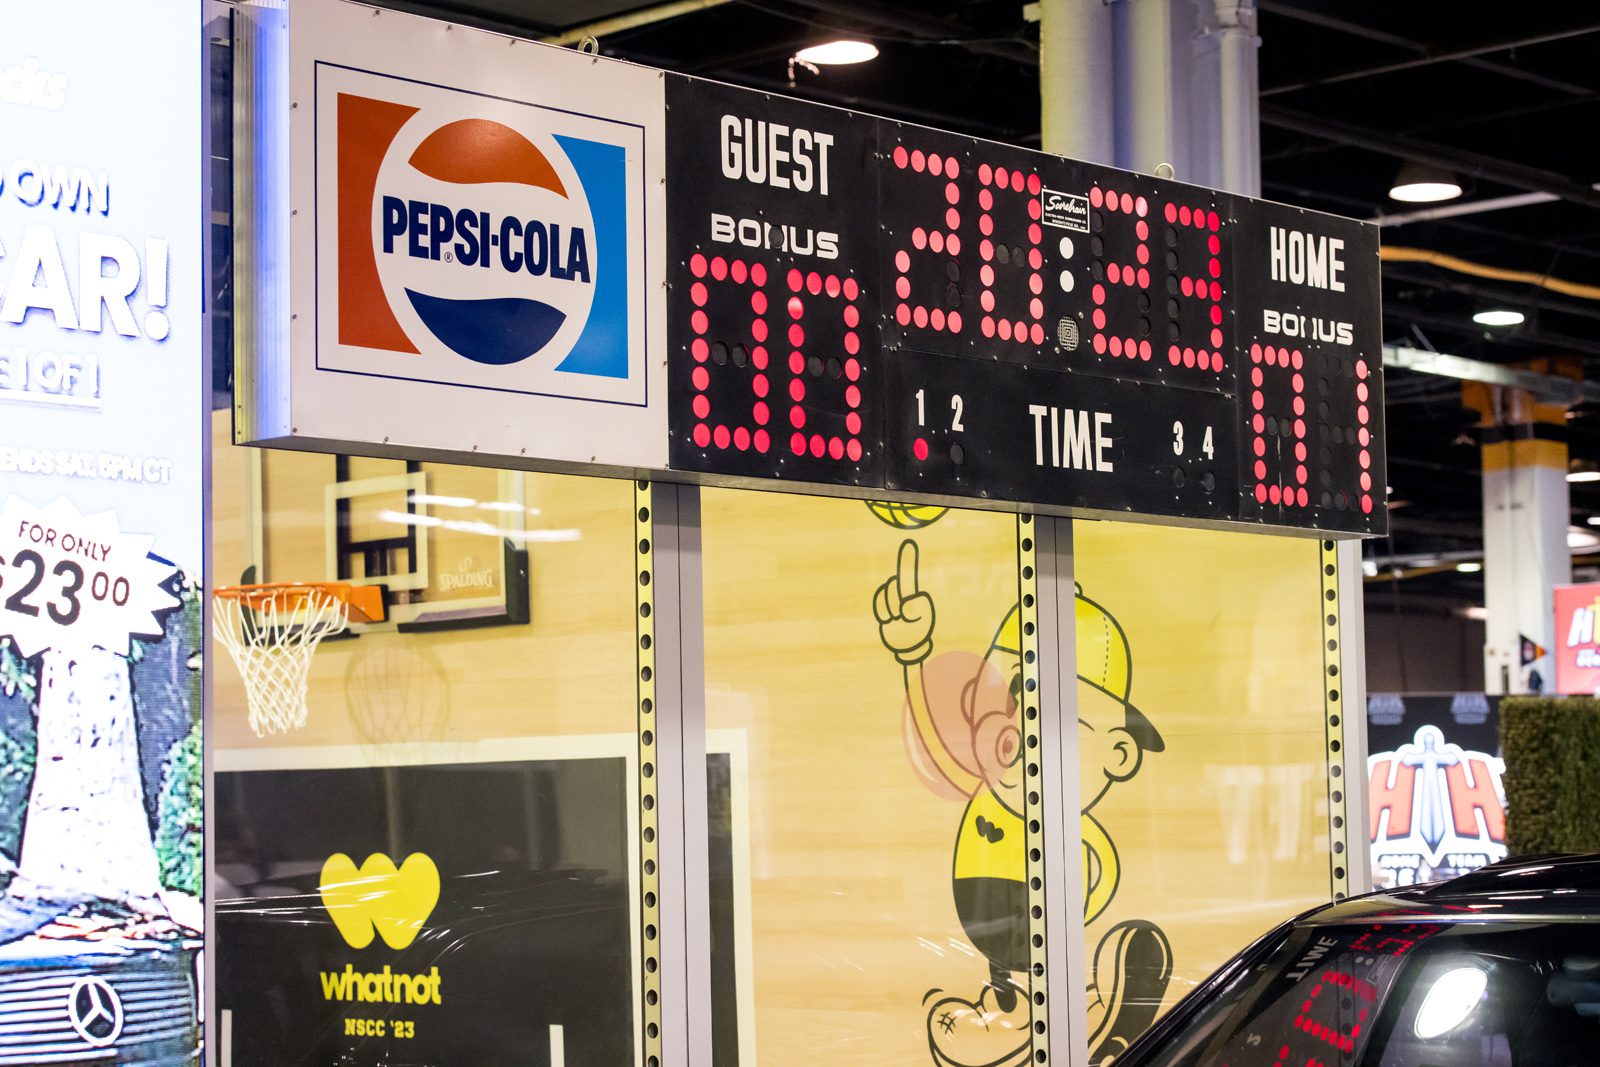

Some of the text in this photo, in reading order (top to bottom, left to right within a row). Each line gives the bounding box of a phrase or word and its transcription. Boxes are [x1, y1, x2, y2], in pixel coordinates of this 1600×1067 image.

[720, 114, 834, 196] GUEST
[0, 158, 109, 217] OWN
[382, 195, 591, 284] PEPSI-COLA
[711, 212, 839, 260] BONUS
[1270, 226, 1345, 293] HOME
[0, 224, 171, 343] AR!
[1263, 309, 1354, 346] BONUS
[33, 350, 82, 392] OF
[915, 388, 964, 432] 1 2
[1029, 404, 1114, 473] TIME
[1172, 420, 1215, 460] 3 4
[143, 457, 173, 485] CT
[18, 520, 111, 562] FOR ONLY
[0, 549, 84, 626] 23
[439, 568, 494, 592] SPALDING
[320, 963, 441, 1005] whatnot
[344, 1018, 415, 1039] NSCC '23
